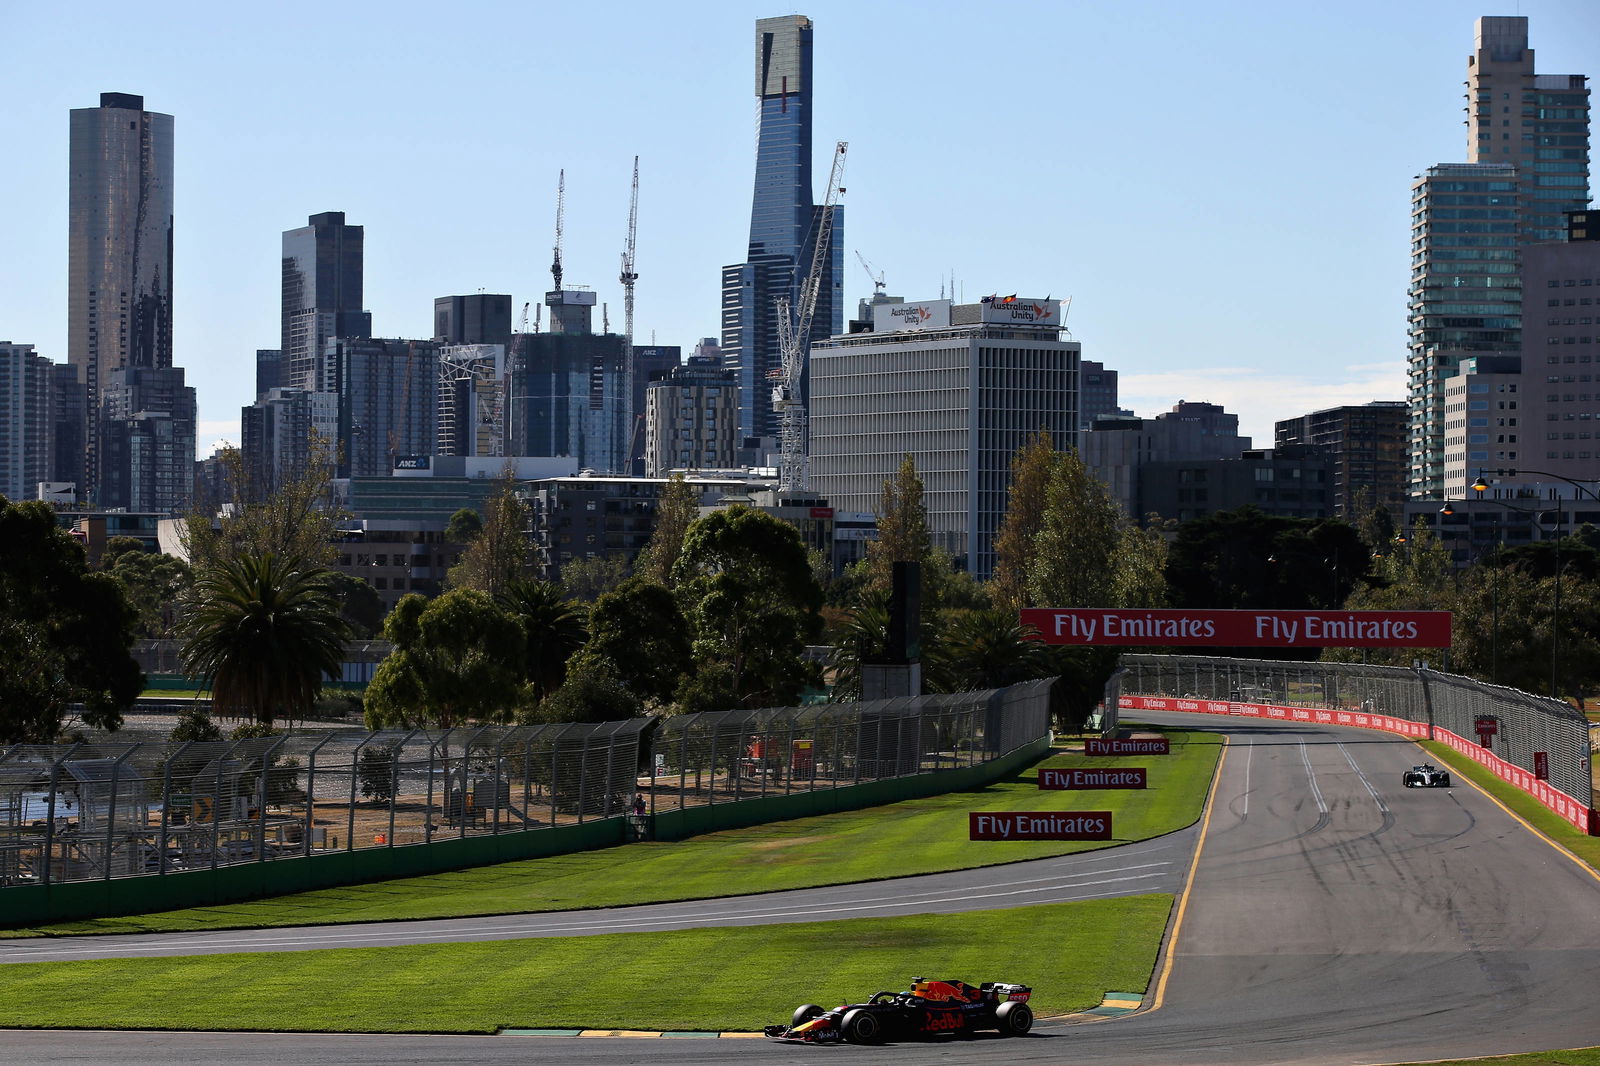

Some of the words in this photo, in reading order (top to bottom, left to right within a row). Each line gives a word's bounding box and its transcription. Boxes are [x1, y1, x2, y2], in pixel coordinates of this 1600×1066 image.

[890, 306, 919, 316] Australian
[990, 302, 1034, 311] Australian
[904, 314, 919, 325] Unity
[1011, 310, 1034, 322] Unity
[398, 460, 417, 468] ANZ
[1054, 613, 1097, 642] Fly
[1102, 613, 1216, 638] Emirates
[1255, 615, 1298, 643] Fly
[1304, 615, 1418, 639] Emirates
[1089, 741, 1110, 754] Fly
[1112, 740, 1166, 752] Emirates
[1044, 771, 1070, 788] Fly
[1073, 770, 1141, 785] Emirates
[977, 815, 1011, 838] Fly
[1015, 815, 1105, 833] Emirates
